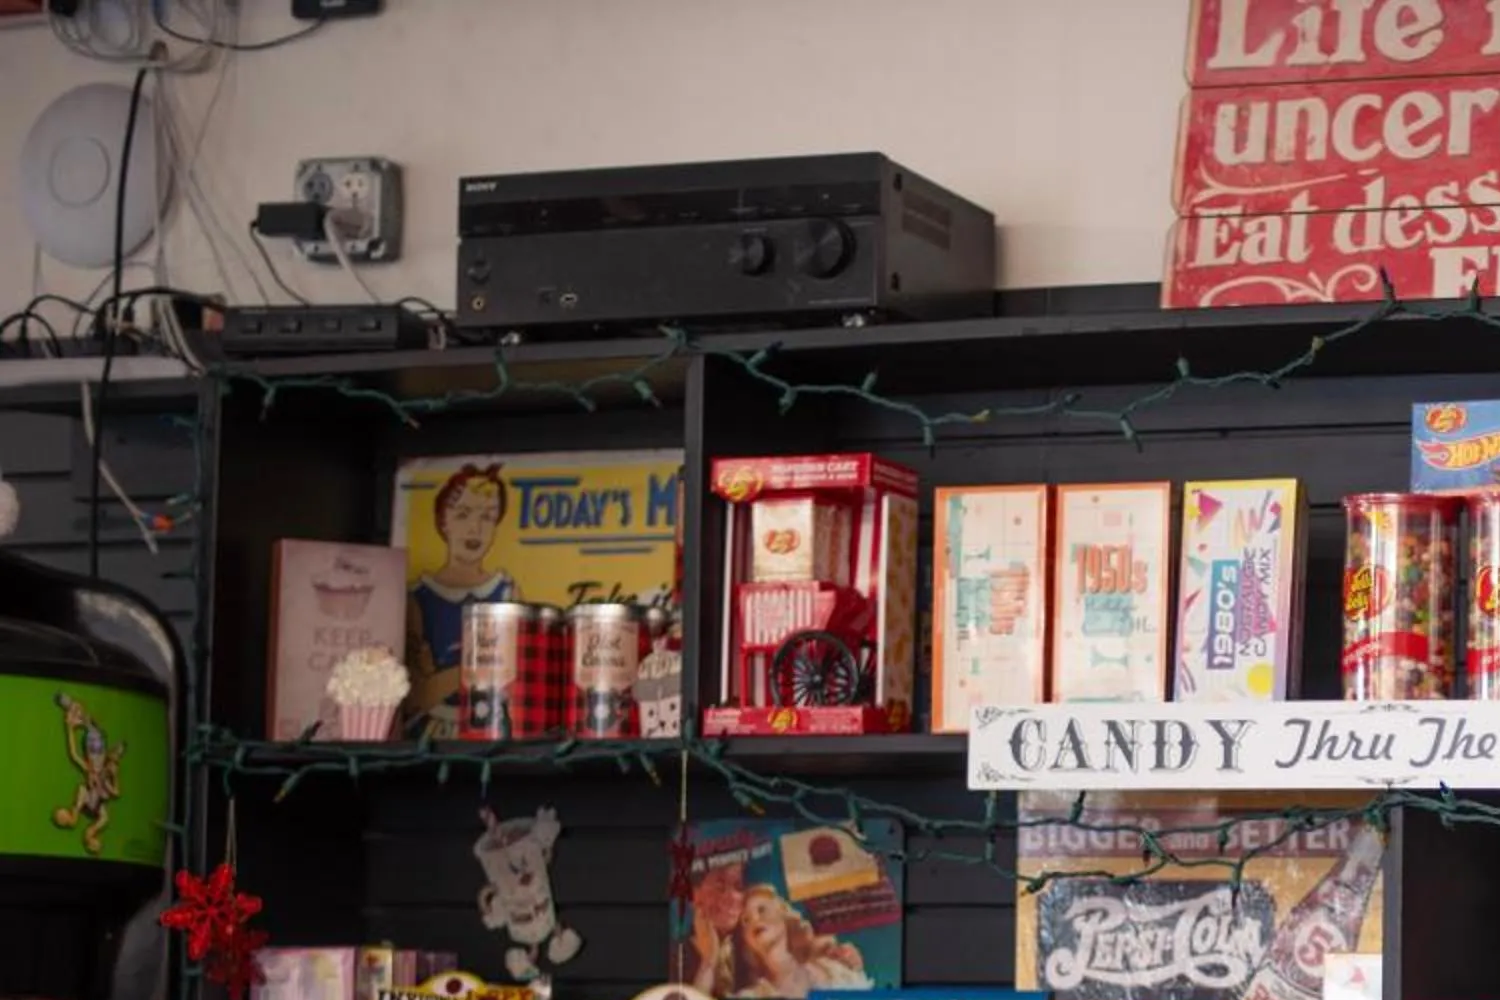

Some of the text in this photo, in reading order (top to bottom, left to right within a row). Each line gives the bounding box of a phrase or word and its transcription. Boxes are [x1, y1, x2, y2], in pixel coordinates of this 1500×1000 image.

[1194, 190, 1311, 267] Eat
[511, 476, 632, 529] TODAY'S
[1008, 717, 1253, 774] CANDY
[1275, 718, 1394, 770] Thru
[1409, 715, 1498, 768] The
[1168, 831, 1211, 851] and
